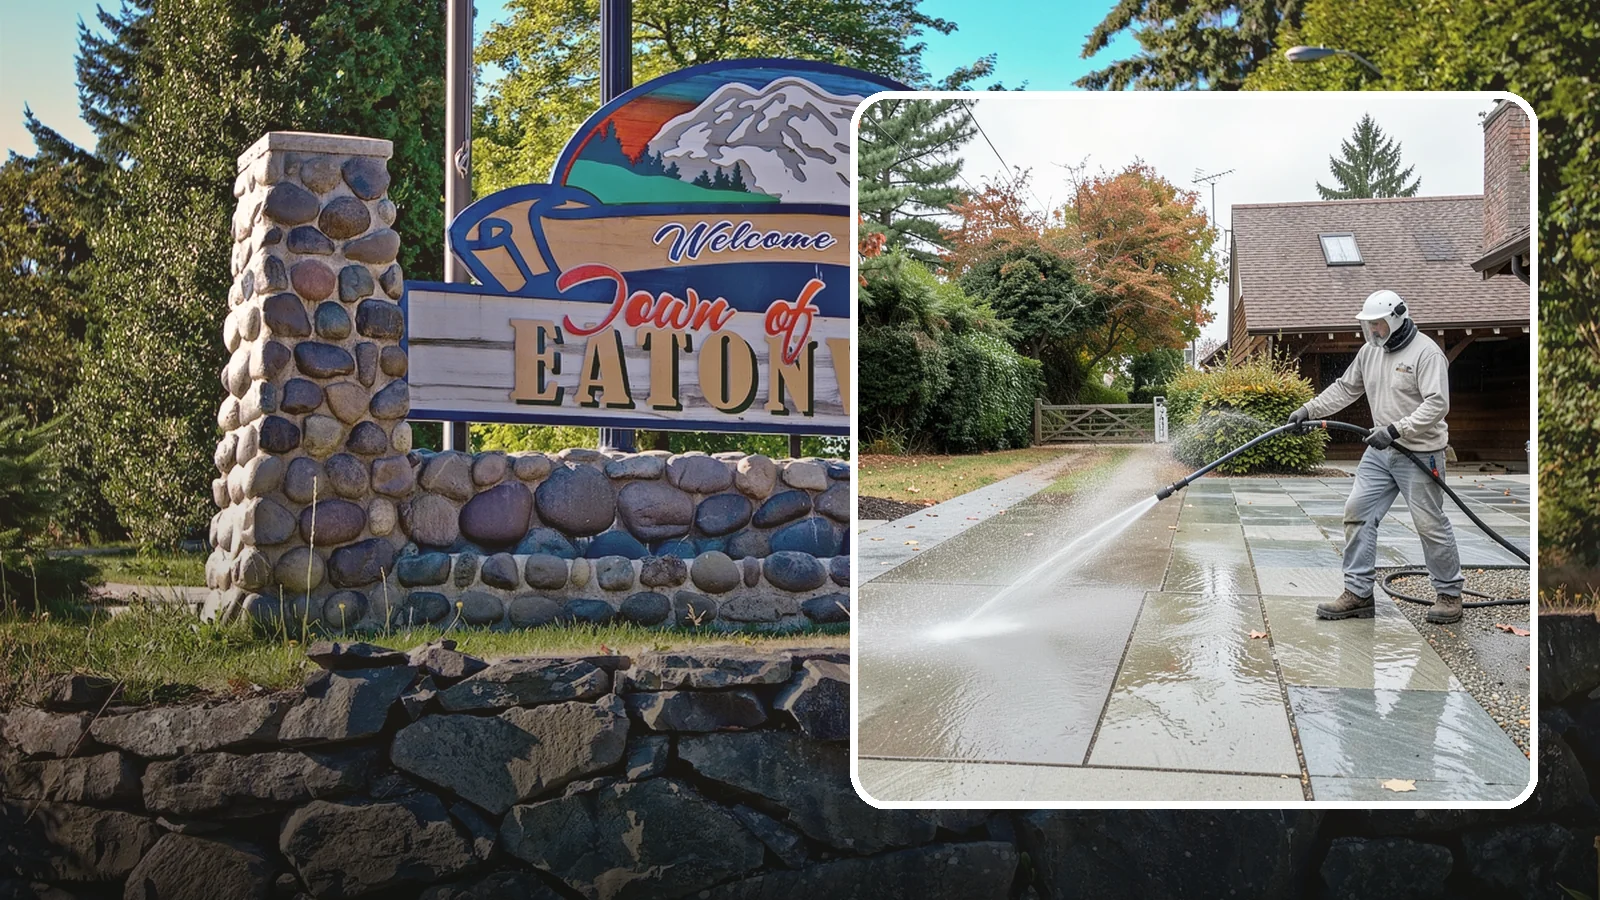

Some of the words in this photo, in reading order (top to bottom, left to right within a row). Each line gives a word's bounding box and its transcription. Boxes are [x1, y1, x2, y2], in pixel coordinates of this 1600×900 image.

[653, 220, 837, 263] Welcome
[557, 263, 736, 336] Town
[764, 278, 826, 365] of
